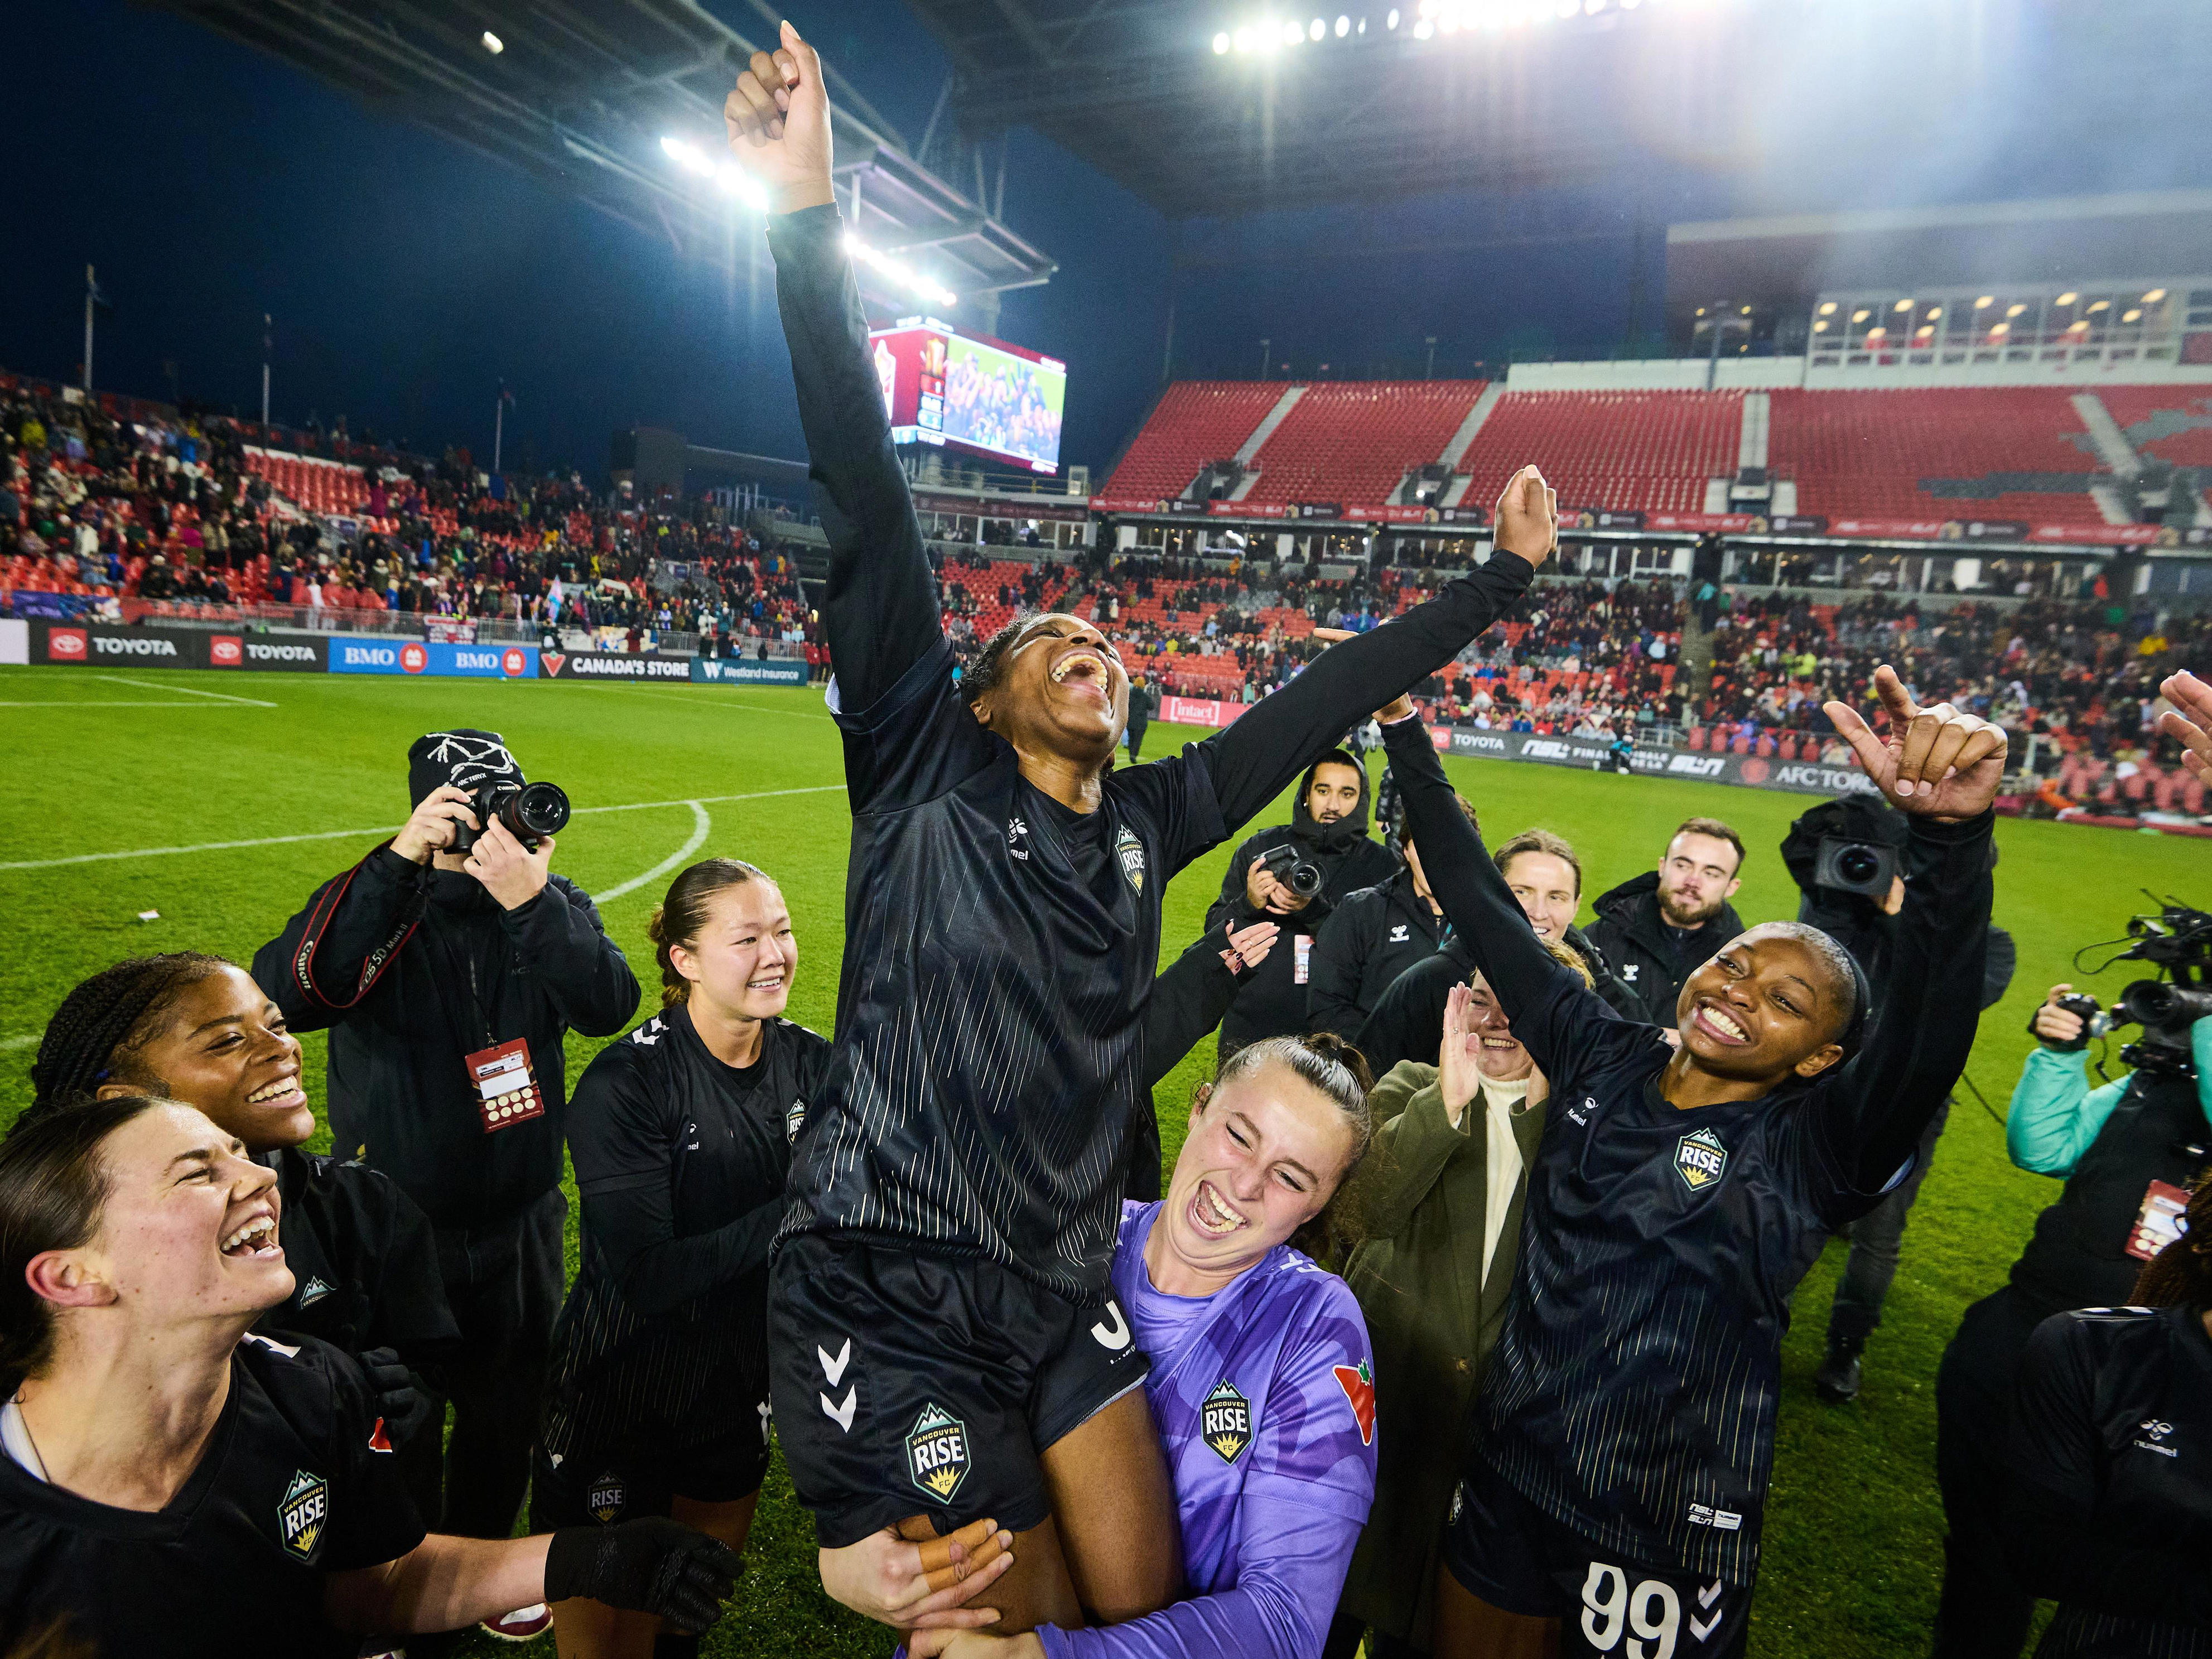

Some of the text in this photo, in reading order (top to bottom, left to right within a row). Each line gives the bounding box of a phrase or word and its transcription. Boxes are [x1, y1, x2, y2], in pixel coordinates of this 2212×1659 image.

[93, 637, 177, 656] TOYOTA
[247, 644, 316, 662] TOYOTA
[344, 647, 395, 665] BMO
[456, 652, 498, 669] BMO
[572, 657, 690, 677] CANADA'S STORE
[724, 666, 799, 681] Westland Insurance
[1454, 734, 1505, 750] TOYOTA
[1776, 766, 1818, 787] AFC
[1119, 843, 1141, 852] VANCOUVER
[1122, 850, 1145, 872] RISE
[372, 948, 388, 965] 5D
[386, 930, 404, 950] Mark
[298, 940, 314, 990] Canon
[1684, 1140, 1723, 1157] VANCOUVER
[1679, 1146, 1721, 1175] RISE
[1205, 1401, 1246, 1410] VANCOUVER
[1206, 1408, 1247, 1434] RISE
[912, 1427, 960, 1446] VANCOUVER
[914, 1435, 965, 1475] RISE
[938, 1479, 951, 1489] FC
[284, 1486, 324, 1513] VANCOUVER
[592, 1489, 622, 1508] RISE
[286, 1494, 324, 1540] RISE
[303, 1537, 312, 1547] FC
[1582, 1562, 1680, 1659] 99
